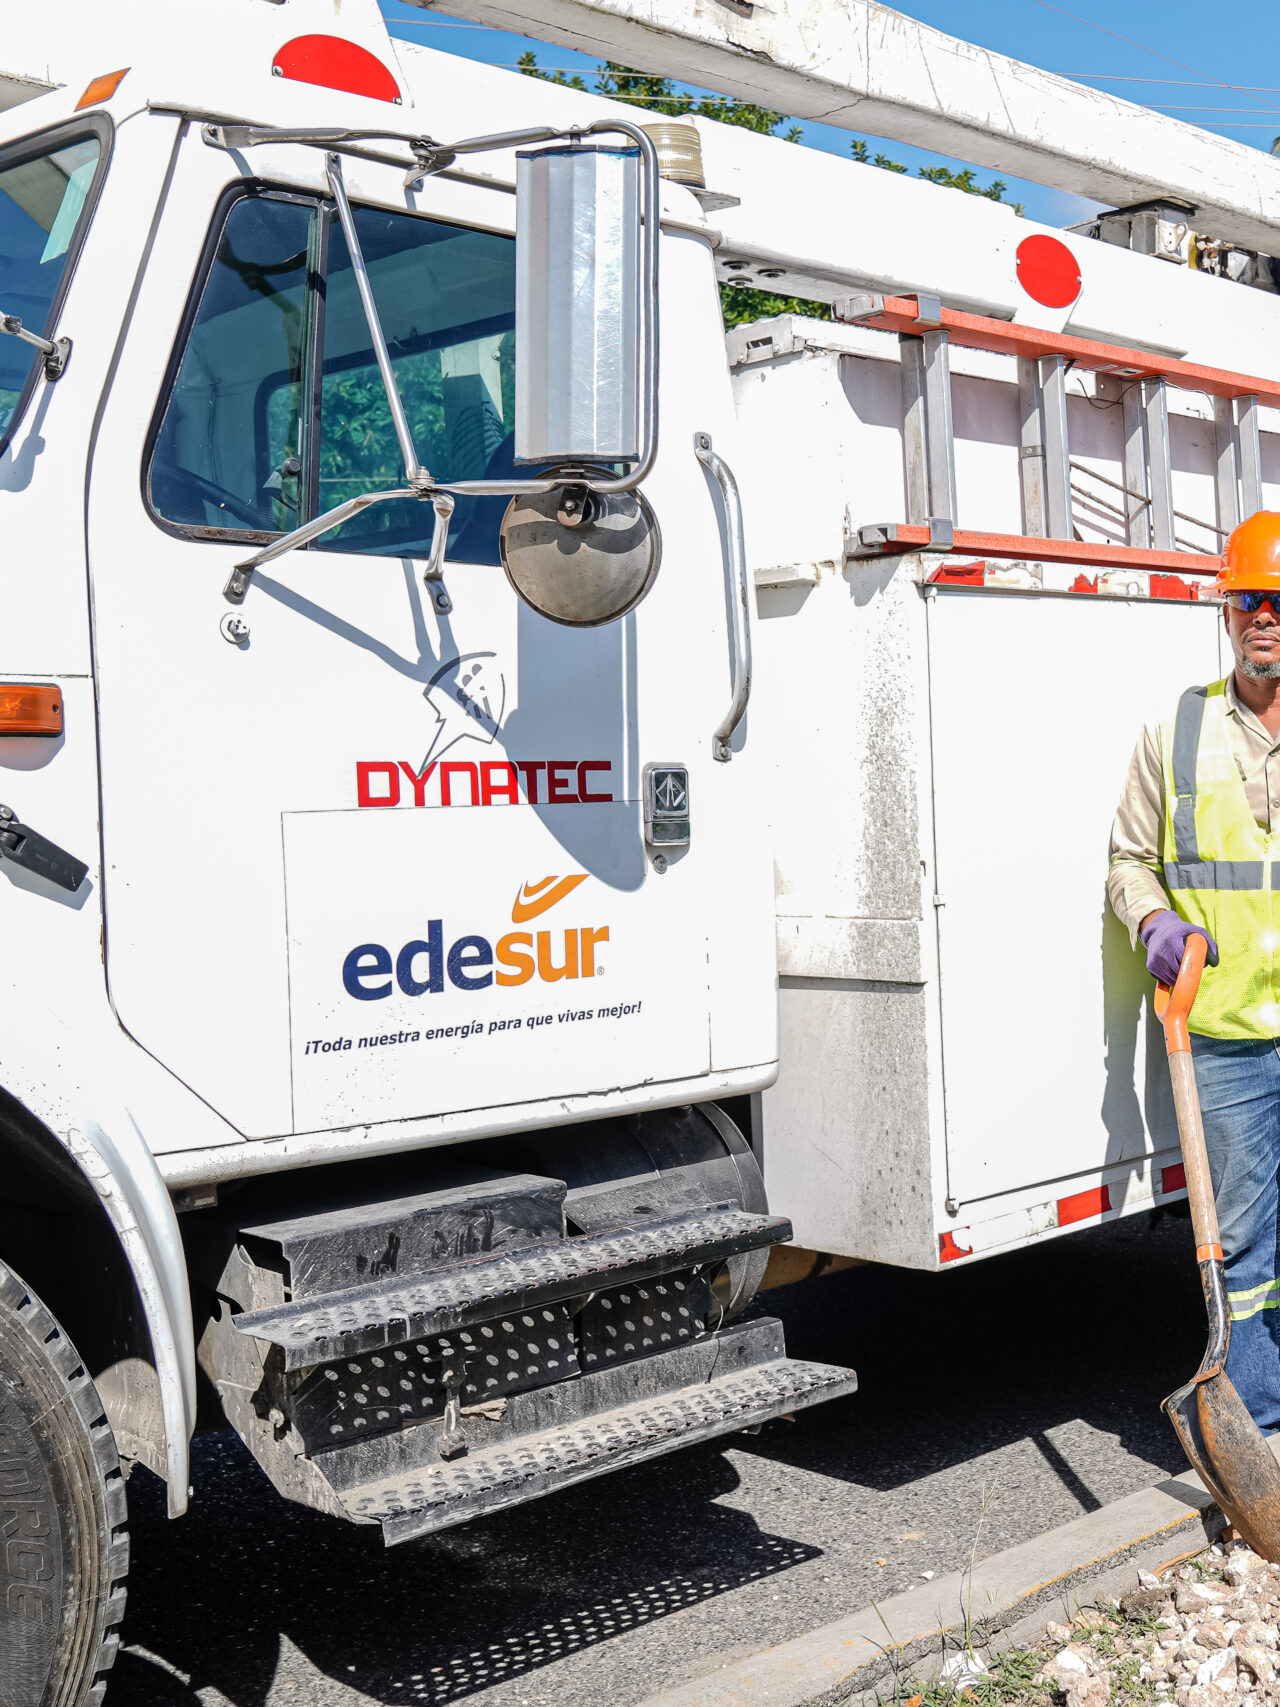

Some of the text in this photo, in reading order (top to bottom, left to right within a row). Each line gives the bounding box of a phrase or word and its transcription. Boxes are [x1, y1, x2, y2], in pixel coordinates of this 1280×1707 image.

[356, 760, 613, 807] DYNATEC
[342, 919, 610, 1001] edesur
[304, 1001, 642, 1055] ¡Toda nuestra energía para que vivas mejor!
